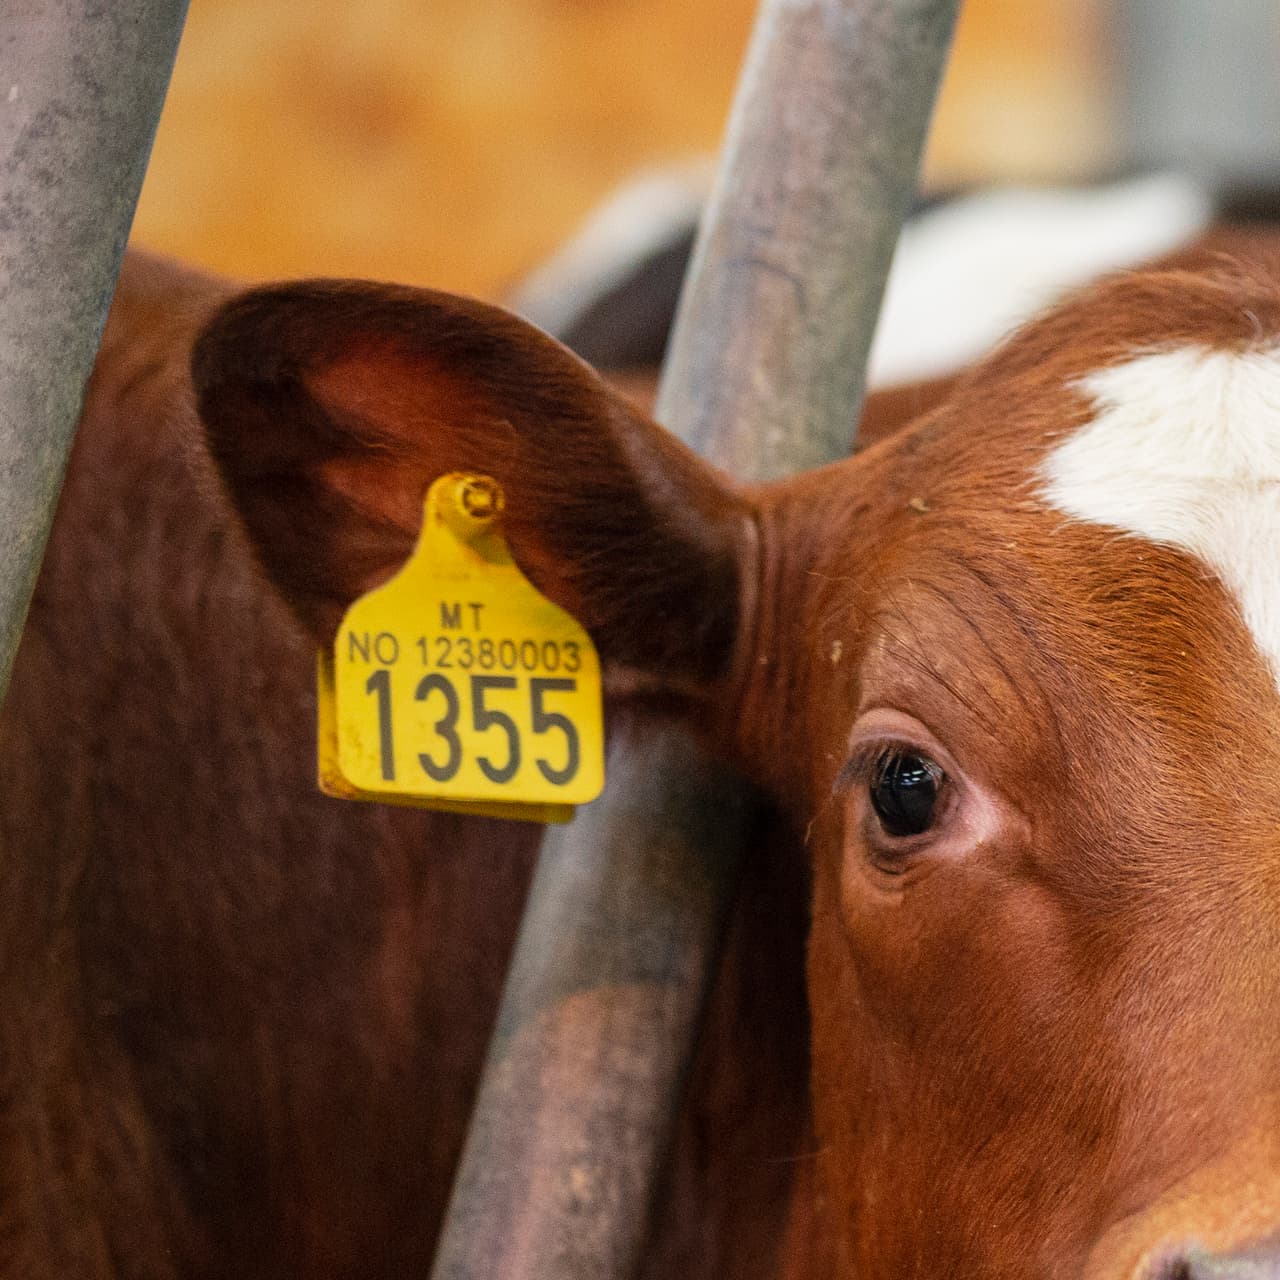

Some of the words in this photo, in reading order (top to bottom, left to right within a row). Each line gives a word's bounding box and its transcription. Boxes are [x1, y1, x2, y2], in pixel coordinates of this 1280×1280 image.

[440, 603, 485, 629] MT
[348, 631, 400, 665] NO
[416, 636, 582, 673] 12380003
[366, 669, 580, 787] 1355
